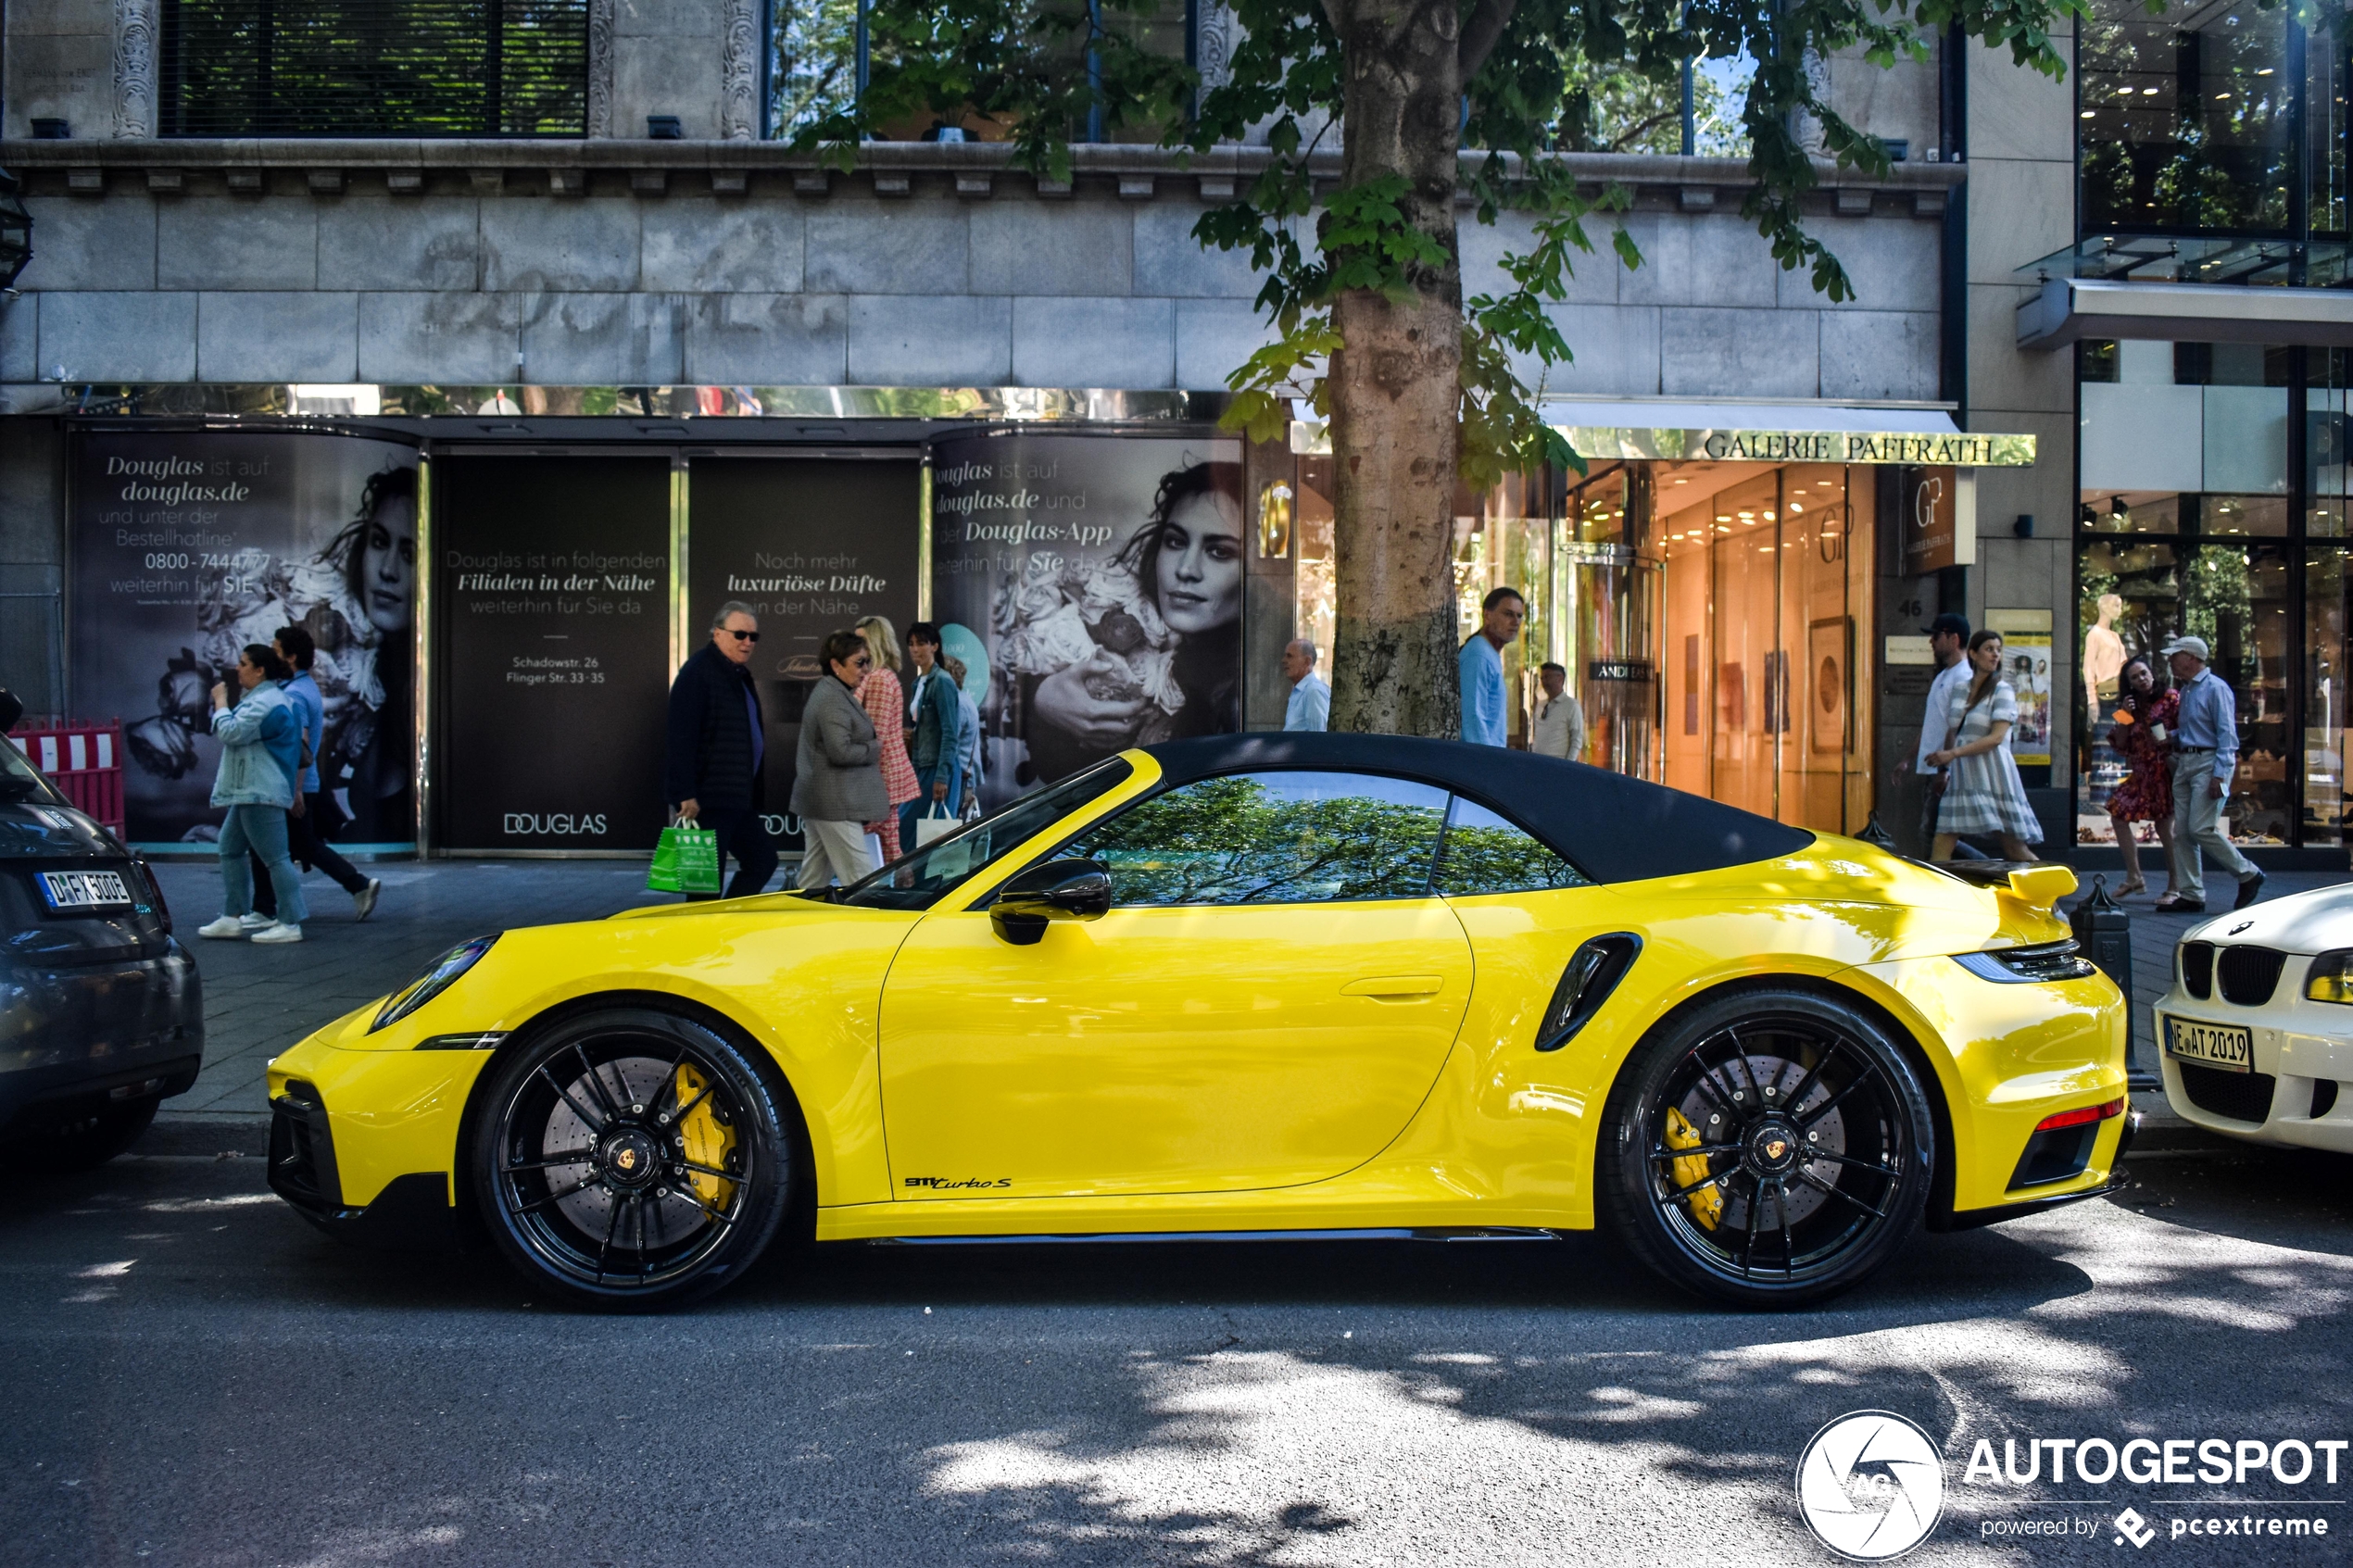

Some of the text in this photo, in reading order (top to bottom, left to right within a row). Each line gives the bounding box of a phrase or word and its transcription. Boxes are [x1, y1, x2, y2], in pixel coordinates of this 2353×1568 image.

[1705, 433, 1993, 463] GALERIE PAFFRATH
[107, 455, 270, 481] Douglas ist auf
[1000, 459, 1019, 479] ist
[1026, 458, 1058, 479] auf
[121, 481, 249, 507] douglas.de
[936, 488, 1086, 516] douglas.de und
[1915, 476, 1942, 528] GP
[99, 507, 219, 524] und unter der
[939, 520, 1112, 546] der Douglas-App
[447, 550, 665, 573] Douglas ist in folgenden
[755, 552, 858, 570] Noch mehr
[997, 550, 1022, 571] für
[1027, 551, 1063, 571] Sie
[1070, 552, 1095, 571] da
[110, 575, 189, 593] weiterhin
[195, 574, 218, 593] für
[223, 575, 254, 594] SIE
[458, 573, 656, 591] Filialen in der Nähe
[728, 573, 887, 595] luxuriöse Düfte
[471, 596, 641, 614] weiterhin für Sie da
[754, 597, 860, 614] in der Nähe
[1898, 599, 1922, 617] 46
[512, 657, 598, 669] Schadowstr. 26
[507, 671, 547, 686] Flinger
[548, 671, 568, 684] Str.
[504, 813, 607, 834] DOUGLAS
[47, 875, 67, 903] D
[2192, 1027, 2206, 1057] AT
[2209, 1029, 2246, 1062] 2019
[905, 1177, 1012, 1189] 911 turbo S
